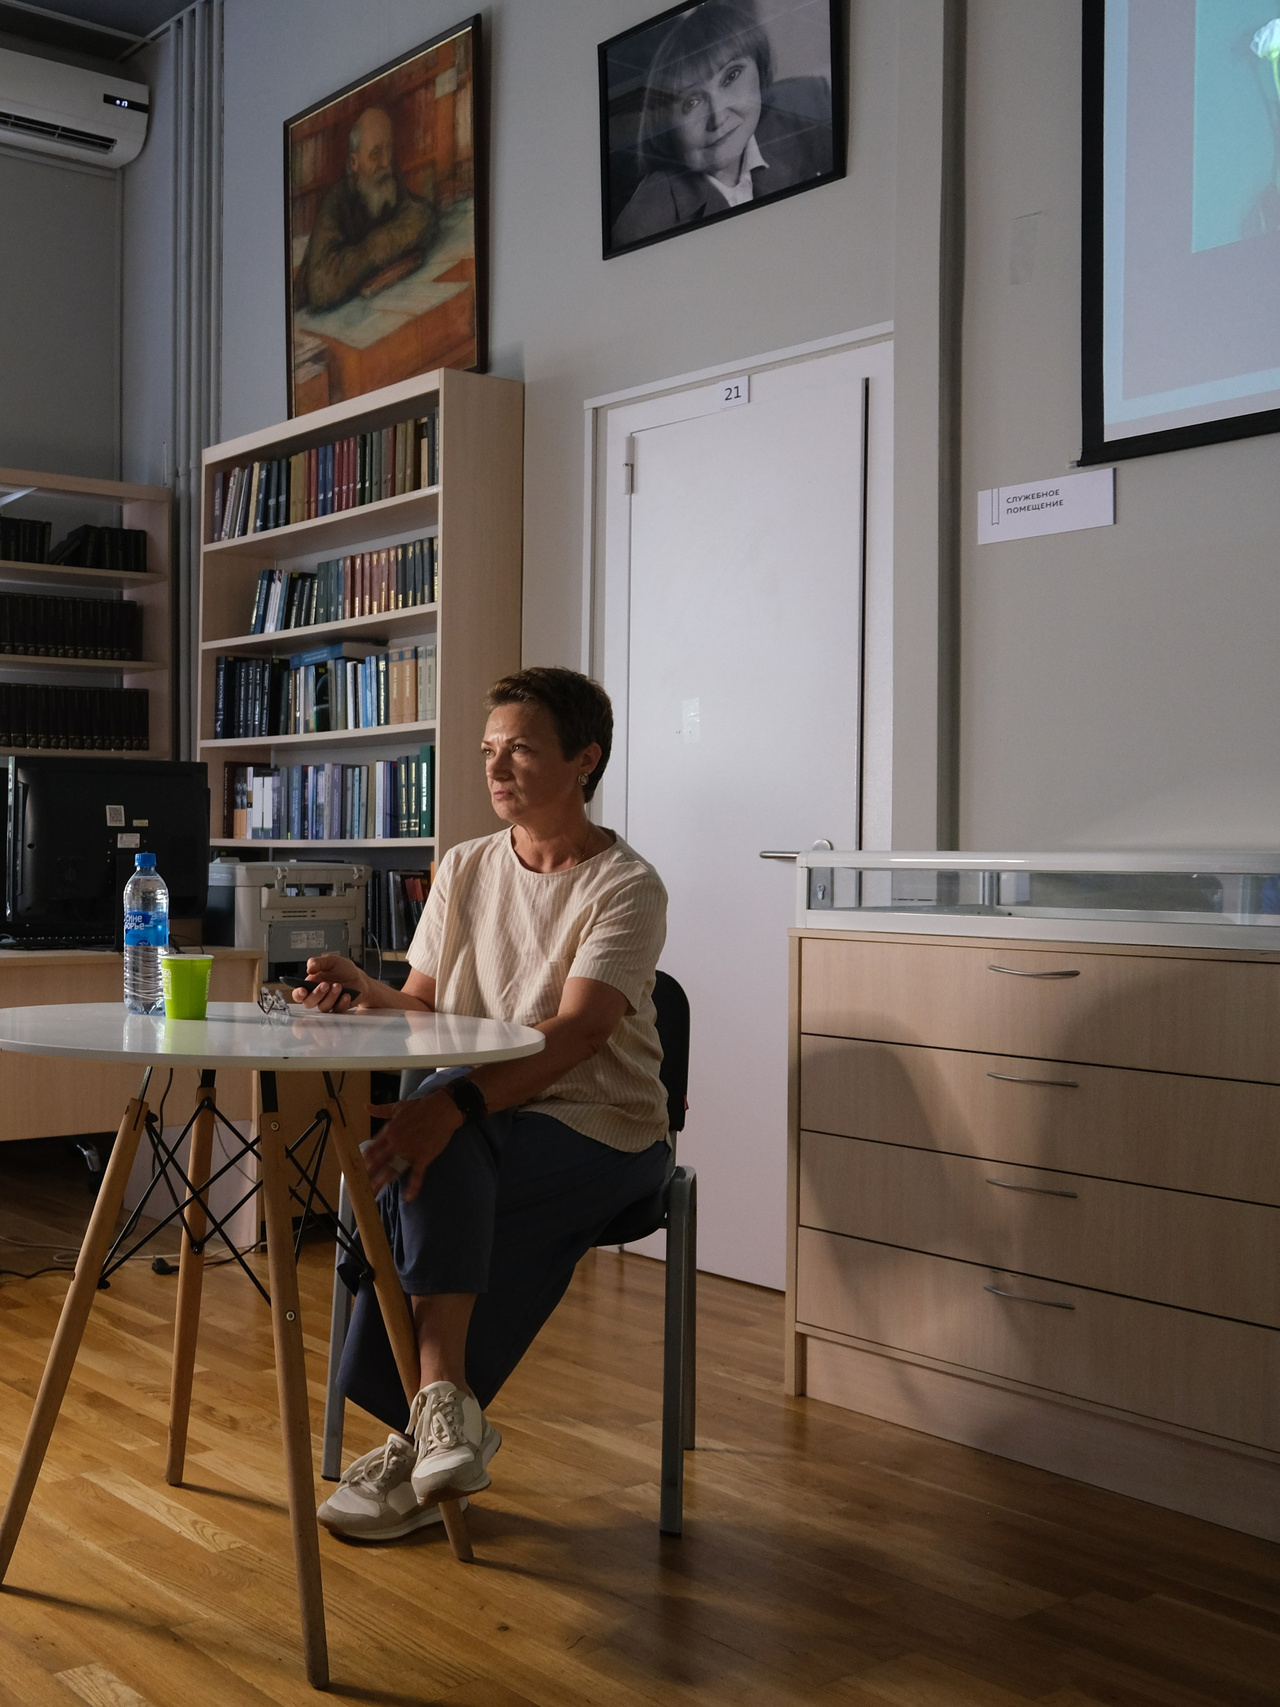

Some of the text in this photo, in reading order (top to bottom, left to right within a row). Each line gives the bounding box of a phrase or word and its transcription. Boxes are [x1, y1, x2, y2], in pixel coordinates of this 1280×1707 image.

[724, 386, 742, 401] 21
[1006, 488, 1060, 504] СЛУЖЕБНОЕ
[1006, 499, 1064, 515] ПОМЕЩЕНИЕ
